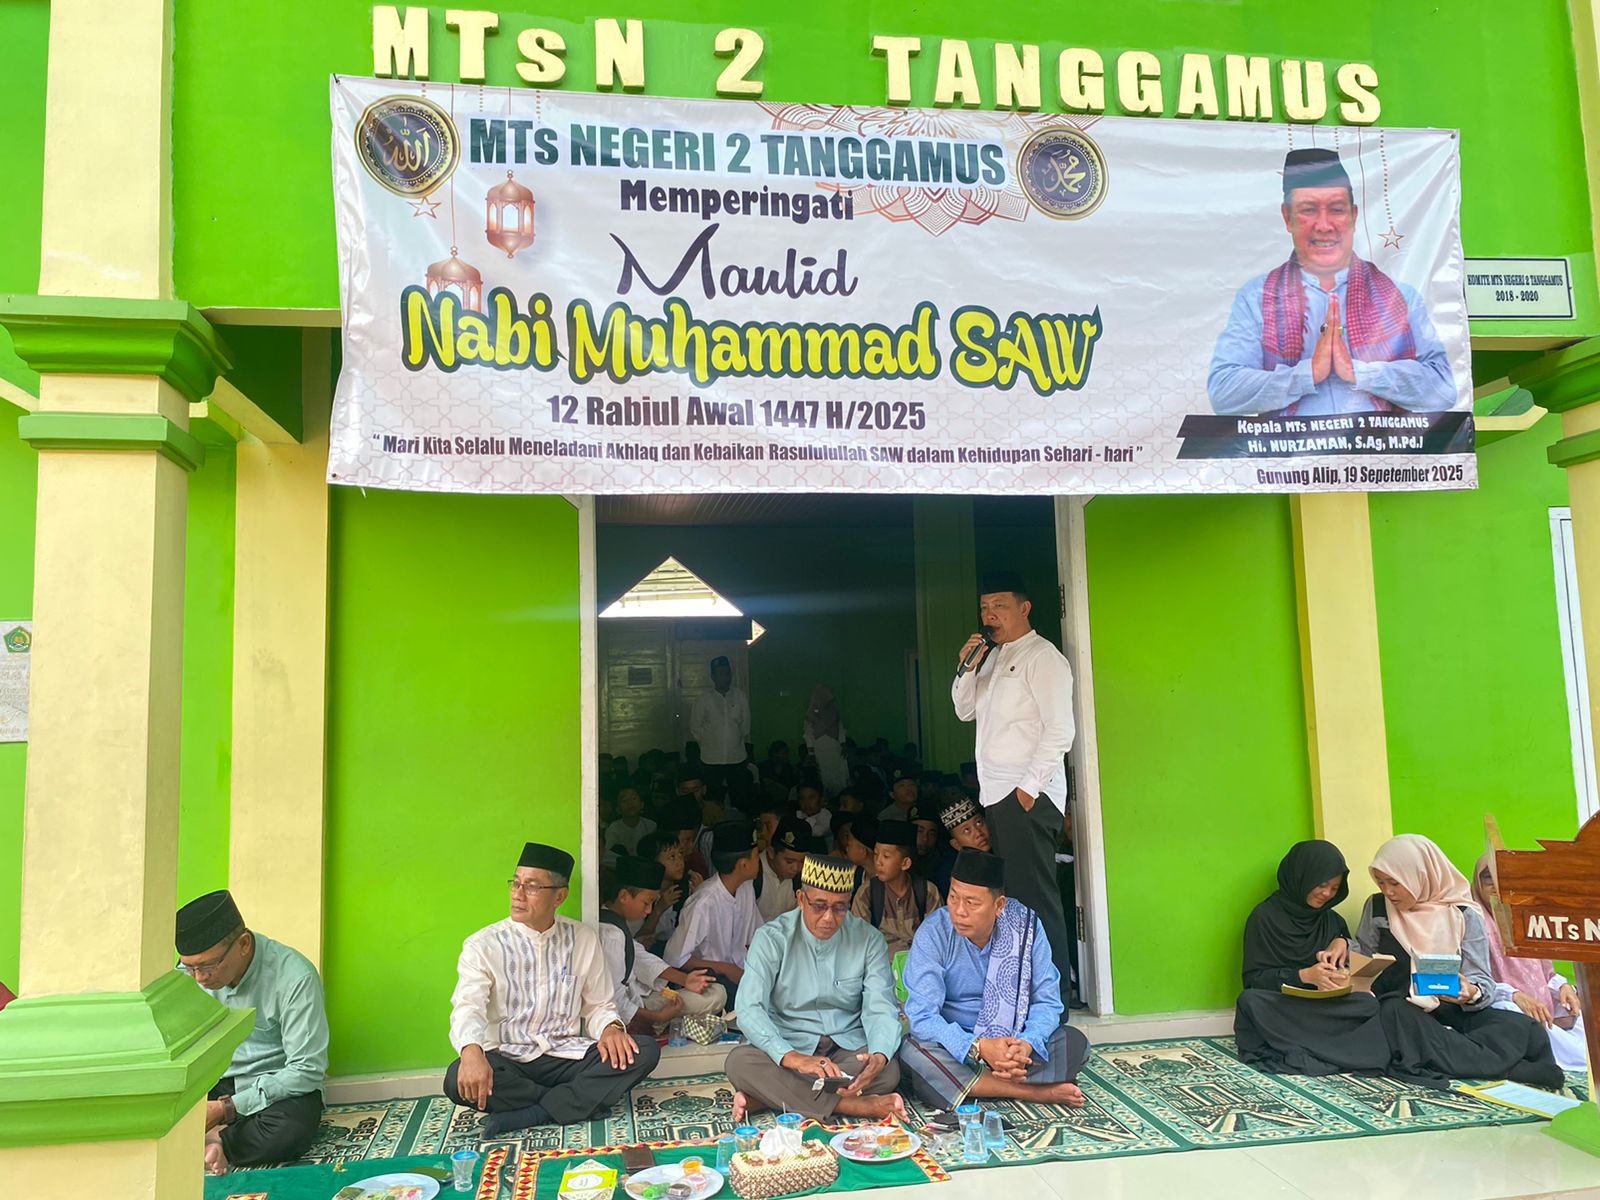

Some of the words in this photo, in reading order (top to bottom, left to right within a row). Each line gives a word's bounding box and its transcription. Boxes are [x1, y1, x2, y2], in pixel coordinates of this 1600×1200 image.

[714, 27, 765, 97] 2
[871, 34, 1382, 126] TANGGAMUS
[469, 118, 558, 166] MTs
[570, 125, 716, 173] NEGERI
[725, 133, 751, 173] 2
[760, 134, 1006, 185] TANGGAMUS
[620, 179, 854, 224] Memperingati
[609, 222, 859, 300] Maulid
[1467, 275, 1491, 286] KOMITE
[1492, 275, 1504, 286] MTS
[1504, 275, 1525, 286] NEGERI
[1526, 276, 1531, 285] 2
[1530, 275, 1563, 286] TANGGAMUS
[1496, 290, 1515, 302] 2018
[1520, 290, 1540, 302] 2020
[401, 285, 557, 372] Nabi
[567, 296, 942, 388] Muhammad
[948, 303, 1102, 398] SAW
[547, 395, 579, 425] 12
[586, 396, 680, 426] Rabiul
[685, 396, 755, 427] Awal
[759, 400, 820, 429] 1447
[825, 400, 926, 431] H/2025
[1237, 419, 1282, 436] Kepala
[1285, 421, 1307, 433] MTs
[1310, 418, 1354, 432] NEGERI
[1359, 418, 1366, 428] 2
[1369, 416, 1430, 429] TANGGAMUS
[423, 436, 451, 456] Kita
[454, 436, 504, 456] Selalu
[508, 437, 603, 459] Meneladani
[606, 442, 659, 463] Akhlaq
[661, 443, 691, 461] dan
[693, 443, 765, 462] Kebaikan
[870, 446, 905, 463] SAW
[907, 446, 955, 464] dalam
[957, 446, 1040, 465] Kehidupan
[1043, 445, 1093, 463] Sehari
[1270, 436, 1352, 453] NURZAMAN,
[1355, 436, 1386, 451] S.Ag,
[1257, 467, 1310, 485] Gunung
[1312, 466, 1342, 485] Alip,
[1343, 466, 1358, 484] 19
[1360, 466, 1430, 485] Sepetember
[1432, 464, 1464, 481] 2025
